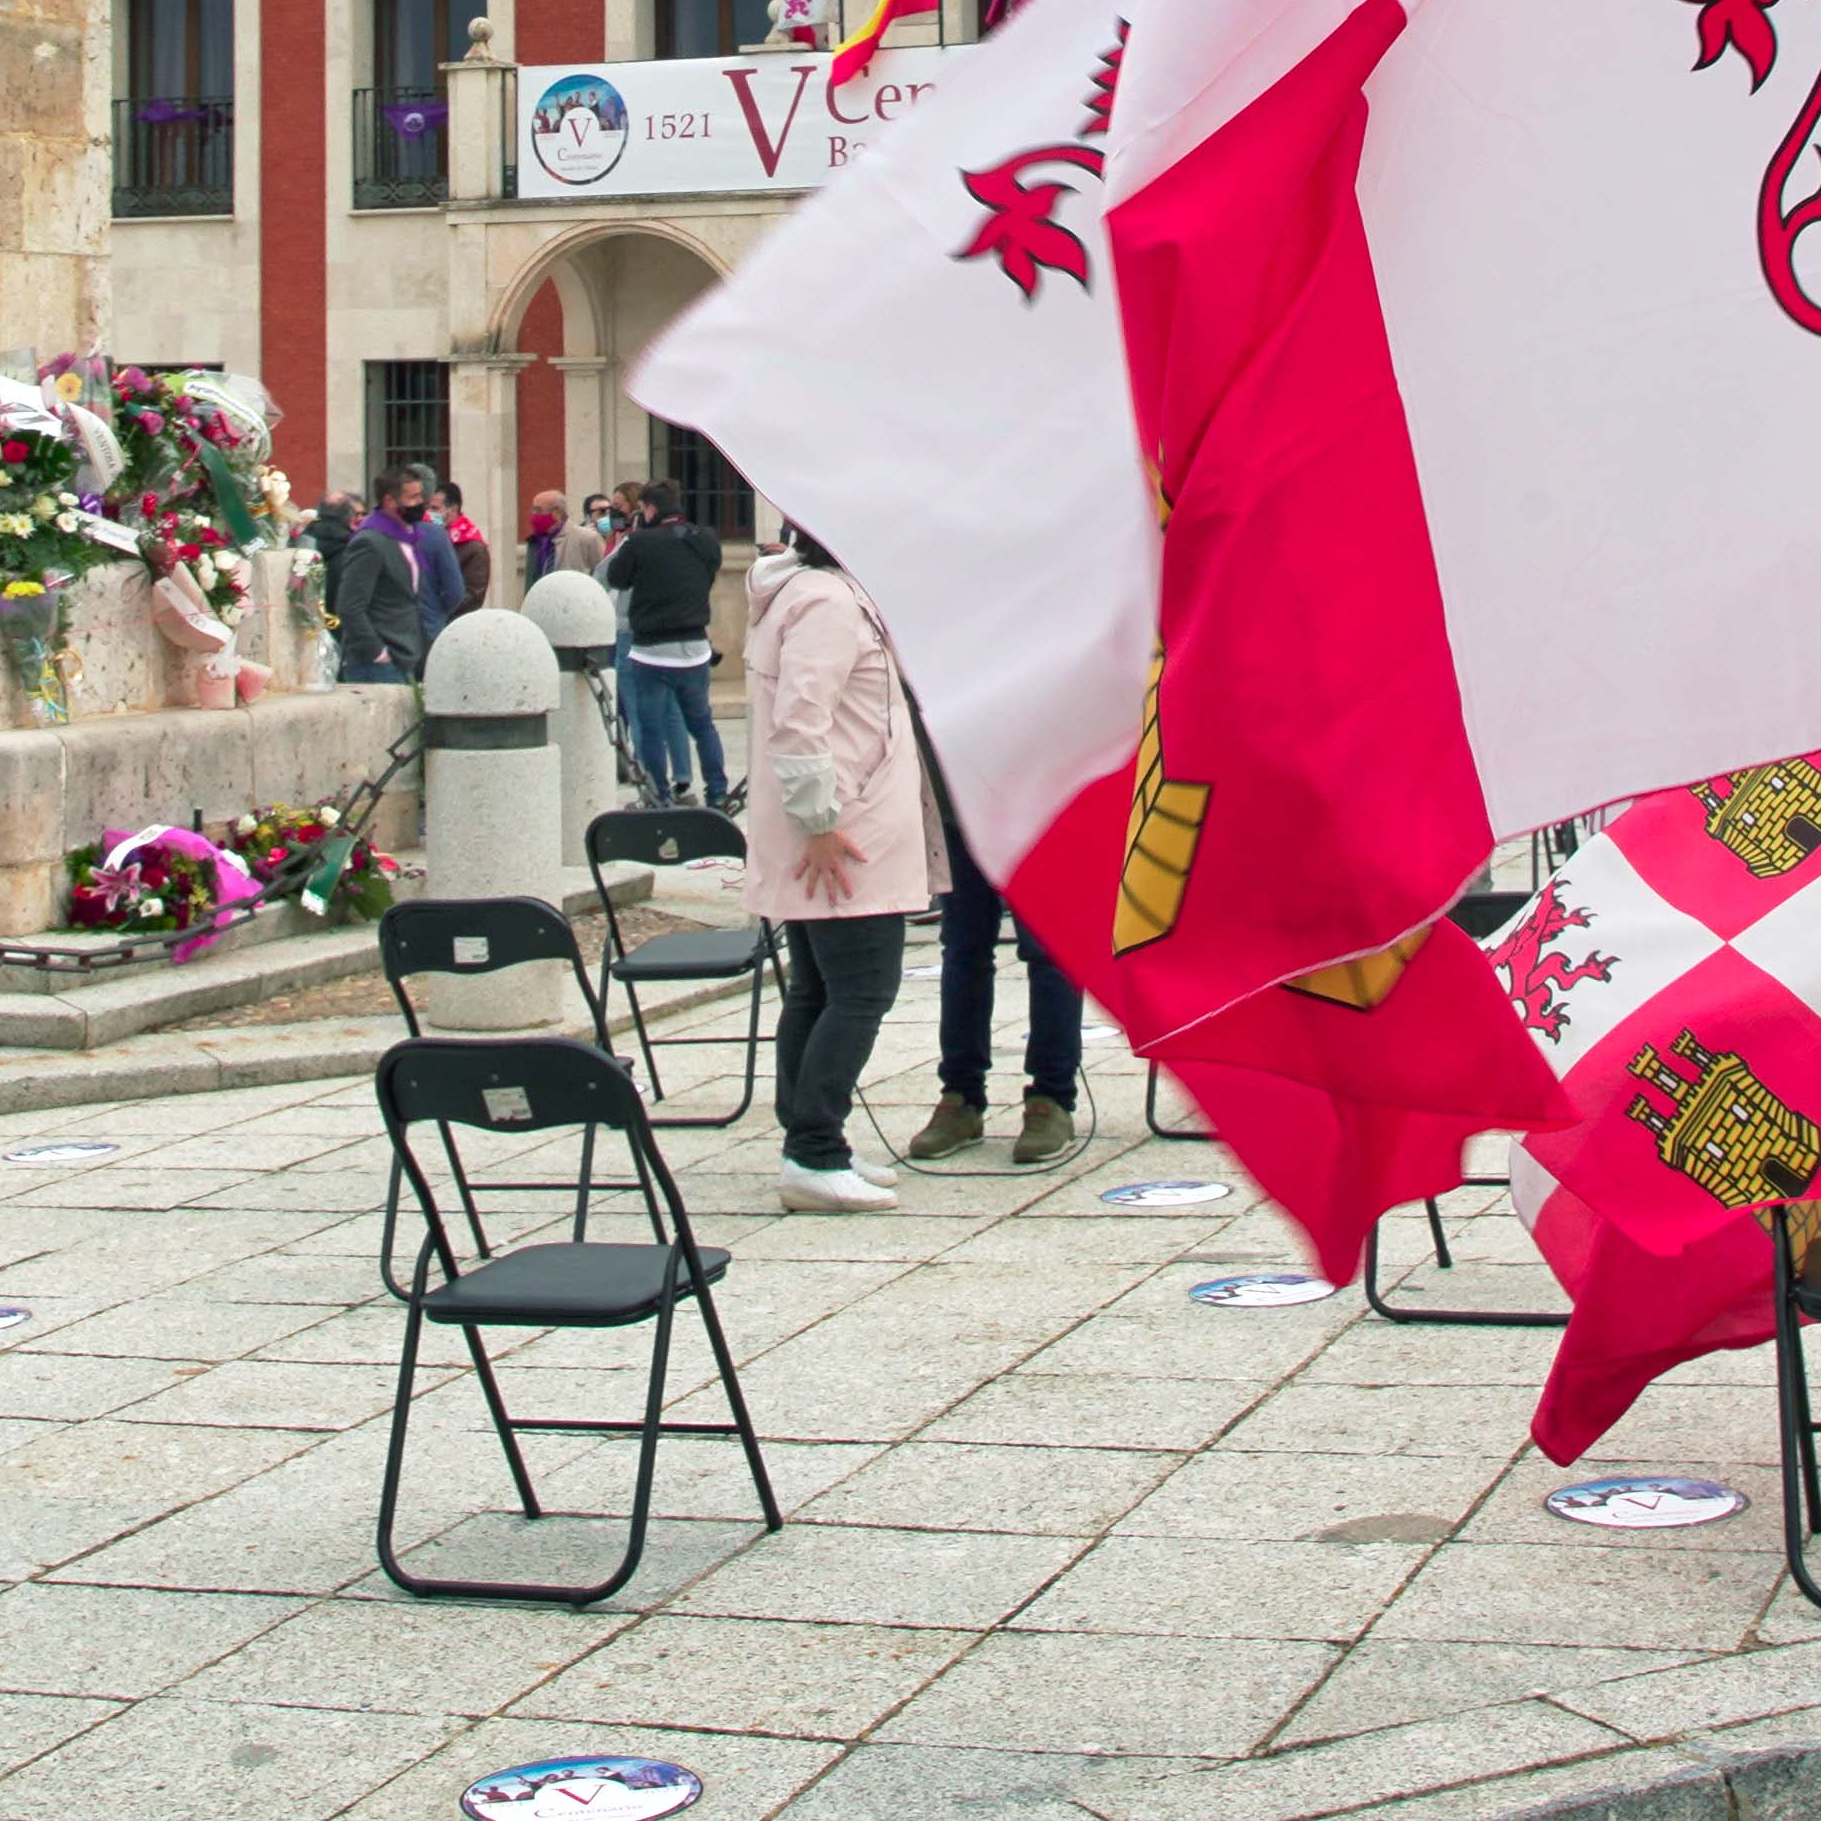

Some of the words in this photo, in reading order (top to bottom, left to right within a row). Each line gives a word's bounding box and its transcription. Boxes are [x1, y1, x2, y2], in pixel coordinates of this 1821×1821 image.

[567, 118, 592, 148] V
[645, 113, 711, 140] 1521
[722, 66, 817, 178] V
[553, 1783, 607, 1805] V
